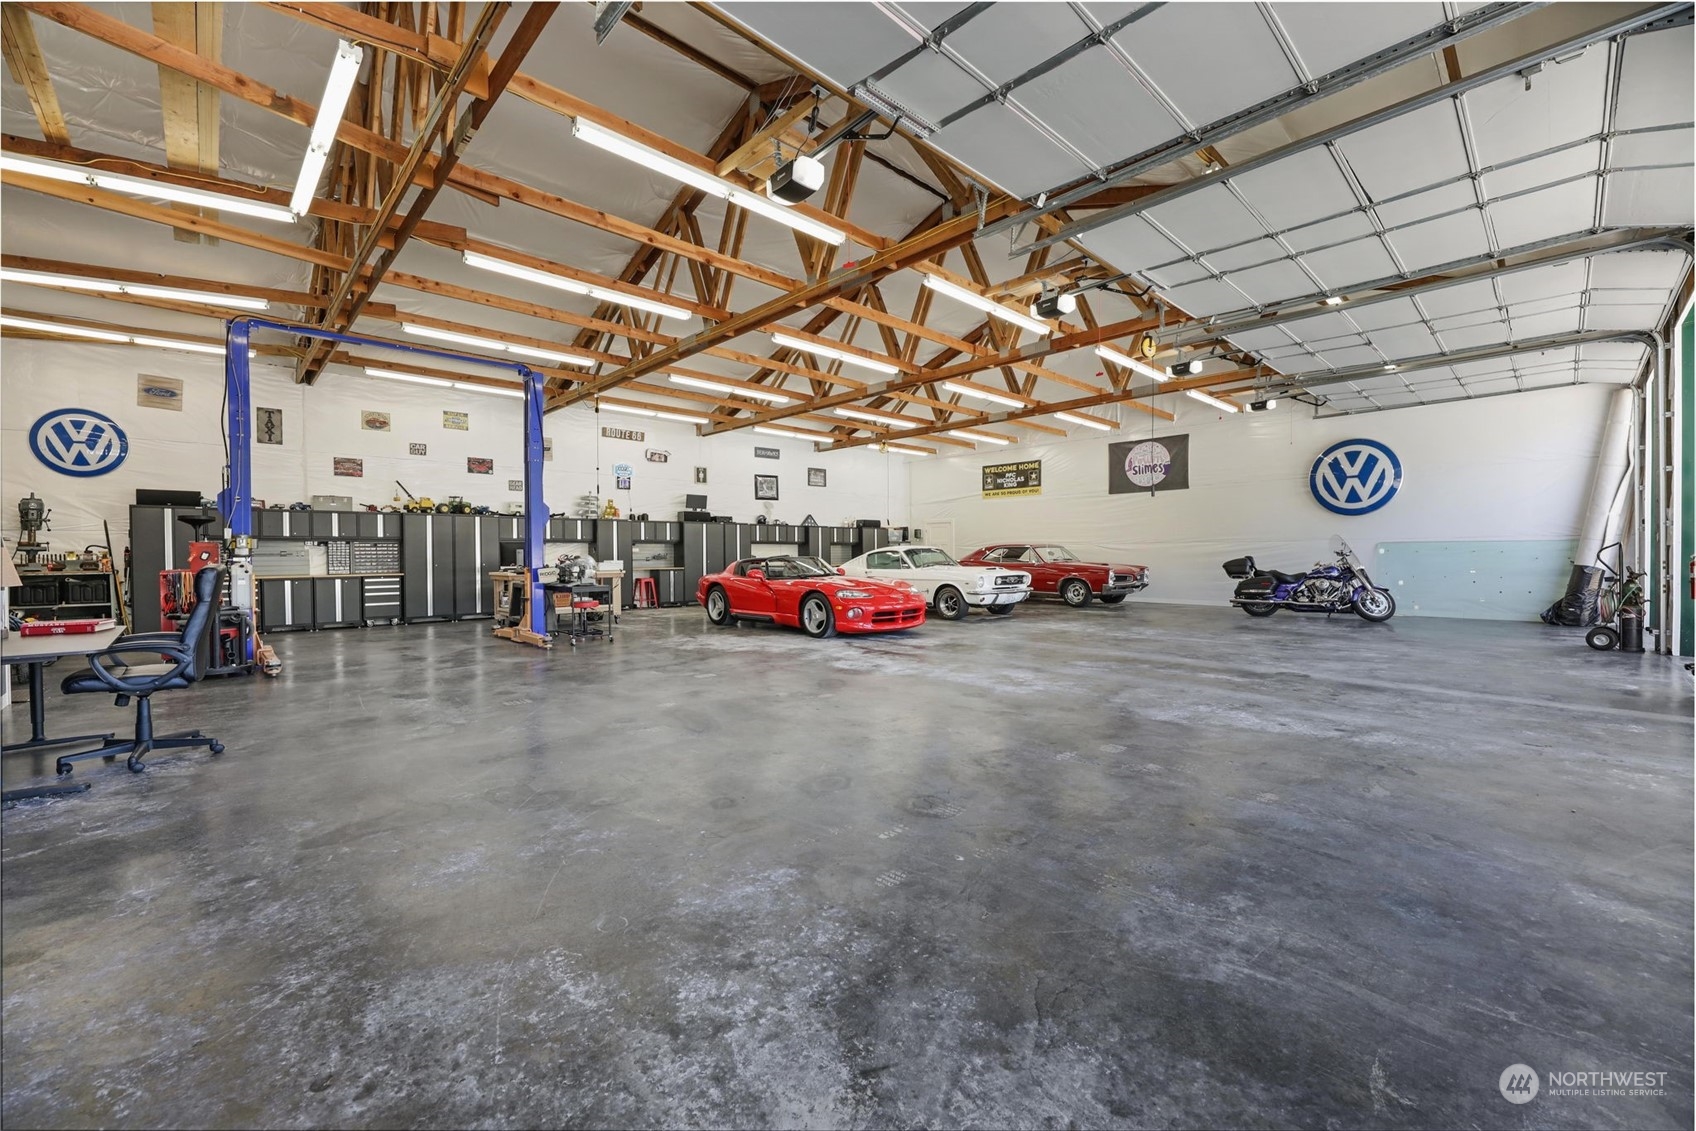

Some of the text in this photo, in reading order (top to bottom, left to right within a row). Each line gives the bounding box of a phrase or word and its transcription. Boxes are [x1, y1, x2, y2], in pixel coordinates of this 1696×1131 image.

[149, 388, 172, 397] Ford
[264, 410, 276, 442] TAXI
[606, 428, 642, 440] ROUTE 66
[984, 461, 1040, 474] WELCOME HOME
[997, 476, 1025, 484] NICHOLAS
